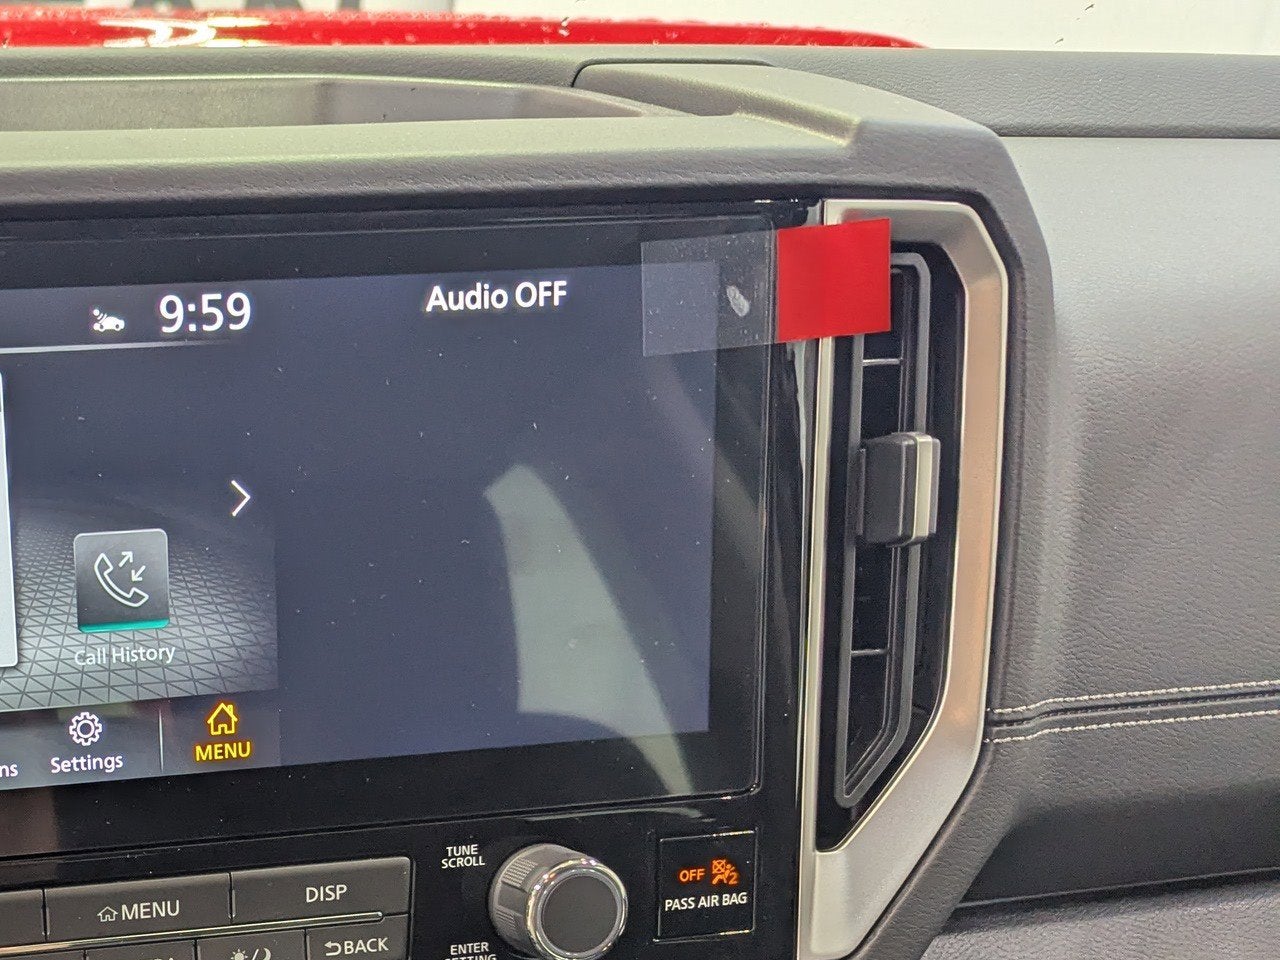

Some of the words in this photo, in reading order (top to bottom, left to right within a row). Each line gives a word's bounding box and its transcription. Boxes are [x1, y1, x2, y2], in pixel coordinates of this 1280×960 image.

[425, 283, 509, 312] Audio
[514, 279, 568, 308] OFF
[159, 290, 252, 333] 9:59
[74, 645, 109, 667] Call
[112, 645, 176, 664] History
[194, 741, 252, 763] MENU
[50, 752, 124, 776] Settings
[446, 844, 479, 857] TUNE
[441, 855, 486, 869] SCROLL
[679, 868, 706, 883] OFF
[305, 884, 347, 902] DISP
[664, 896, 696, 912] PASS
[697, 895, 720, 910] AIR
[721, 891, 748, 907] BAG
[121, 899, 180, 921] MENU
[344, 936, 389, 955] BACK
[450, 941, 490, 956] ENTER
